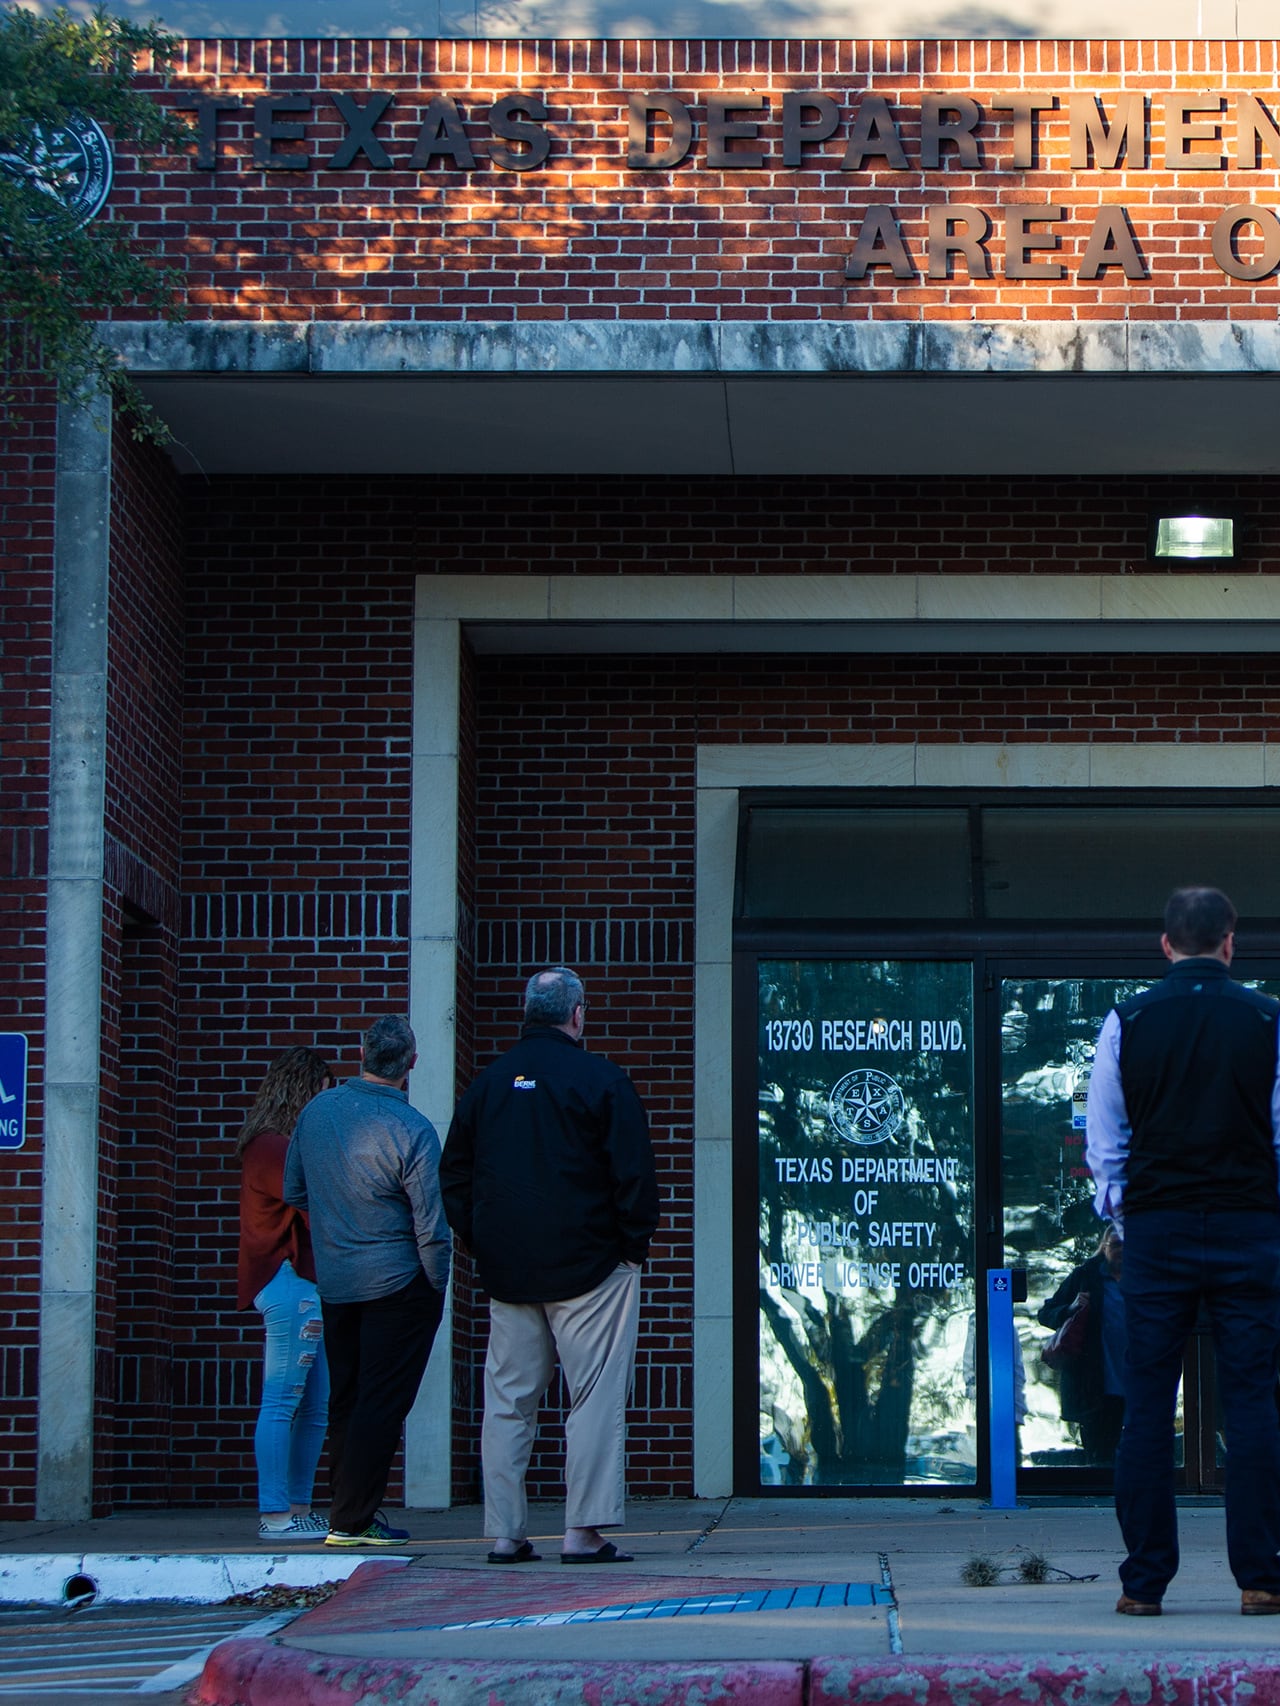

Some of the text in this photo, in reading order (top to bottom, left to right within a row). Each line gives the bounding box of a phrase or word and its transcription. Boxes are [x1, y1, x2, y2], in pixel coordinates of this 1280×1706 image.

[176, 94, 552, 171] TEXAS
[846, 205, 1149, 280] AREA
[765, 1020, 967, 1051] 13730 RESEARCH BLVD.
[775, 1158, 958, 1184] TEXAS DEPARTMENT
[854, 1190, 878, 1215] OF
[797, 1222, 936, 1248] PUBLIC SAFETY
[769, 1262, 965, 1288] DRIVER LICENSE OFFICE
